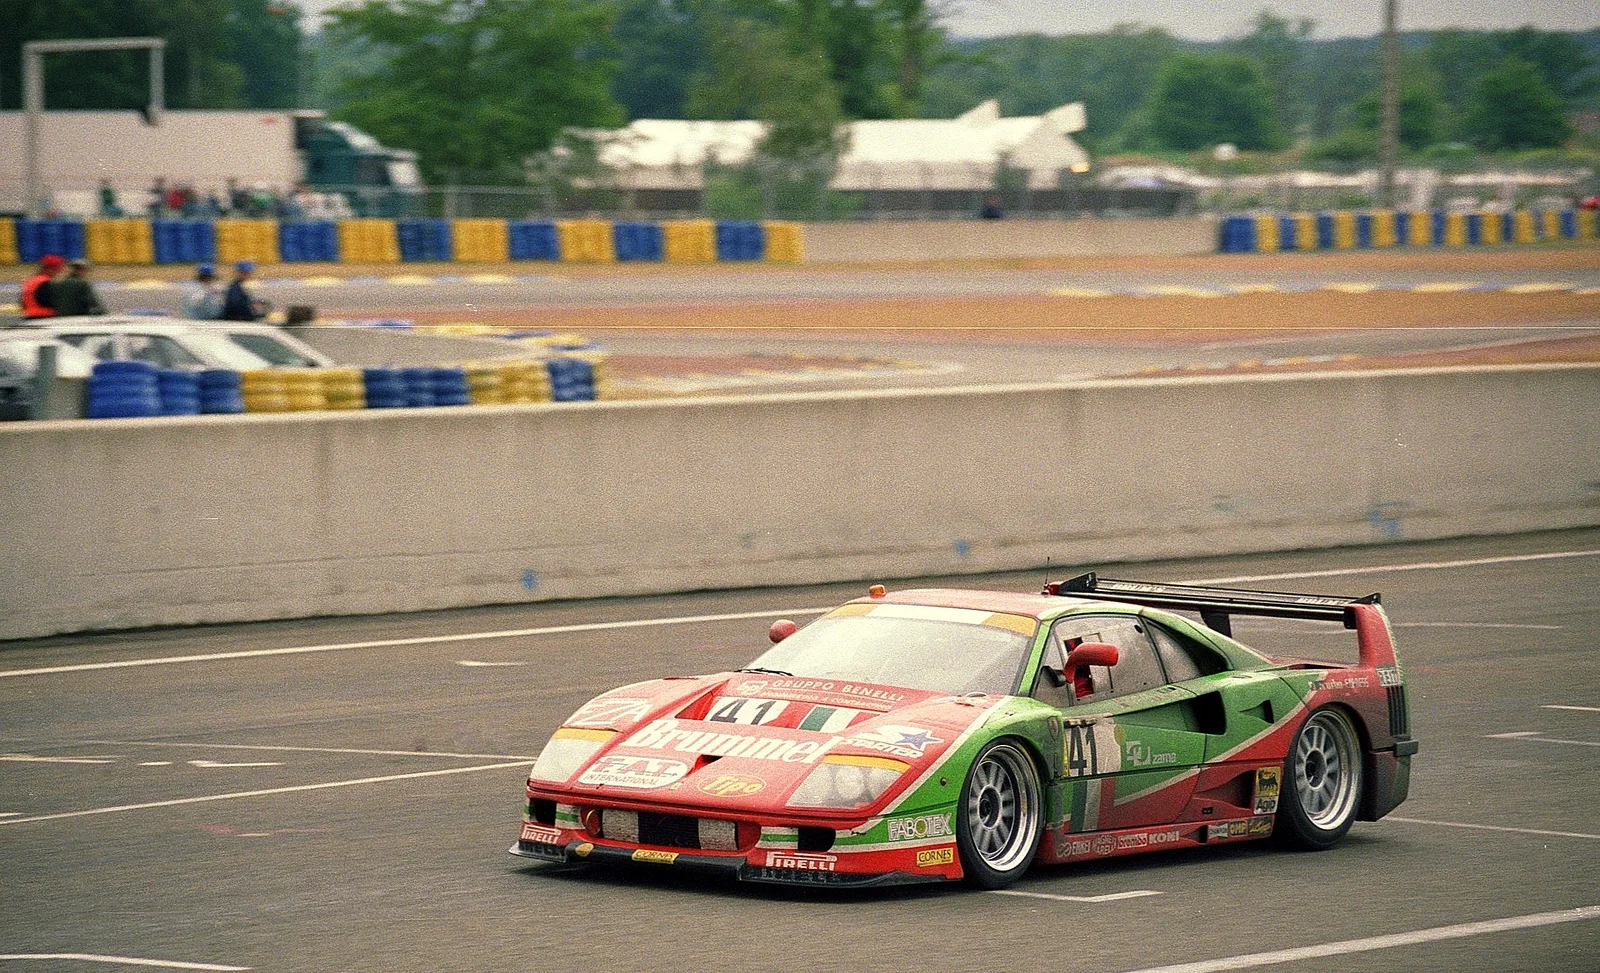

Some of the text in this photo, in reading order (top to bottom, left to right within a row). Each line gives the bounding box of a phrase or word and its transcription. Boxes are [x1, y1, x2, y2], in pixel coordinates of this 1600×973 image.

[772, 679, 834, 691] GRUPPO
[841, 685, 904, 701] BENELLI
[709, 698, 777, 726] 41
[618, 719, 846, 764] Brummel
[1069, 724, 1098, 776] 41
[585, 774, 658, 786] INTERNATIONAL
[521, 824, 562, 844] PIRELLI
[887, 813, 953, 842] FABOTEX
[1149, 831, 1180, 844] KONI
[765, 852, 838, 871] PIRELLI
[917, 850, 952, 862] CORNES
